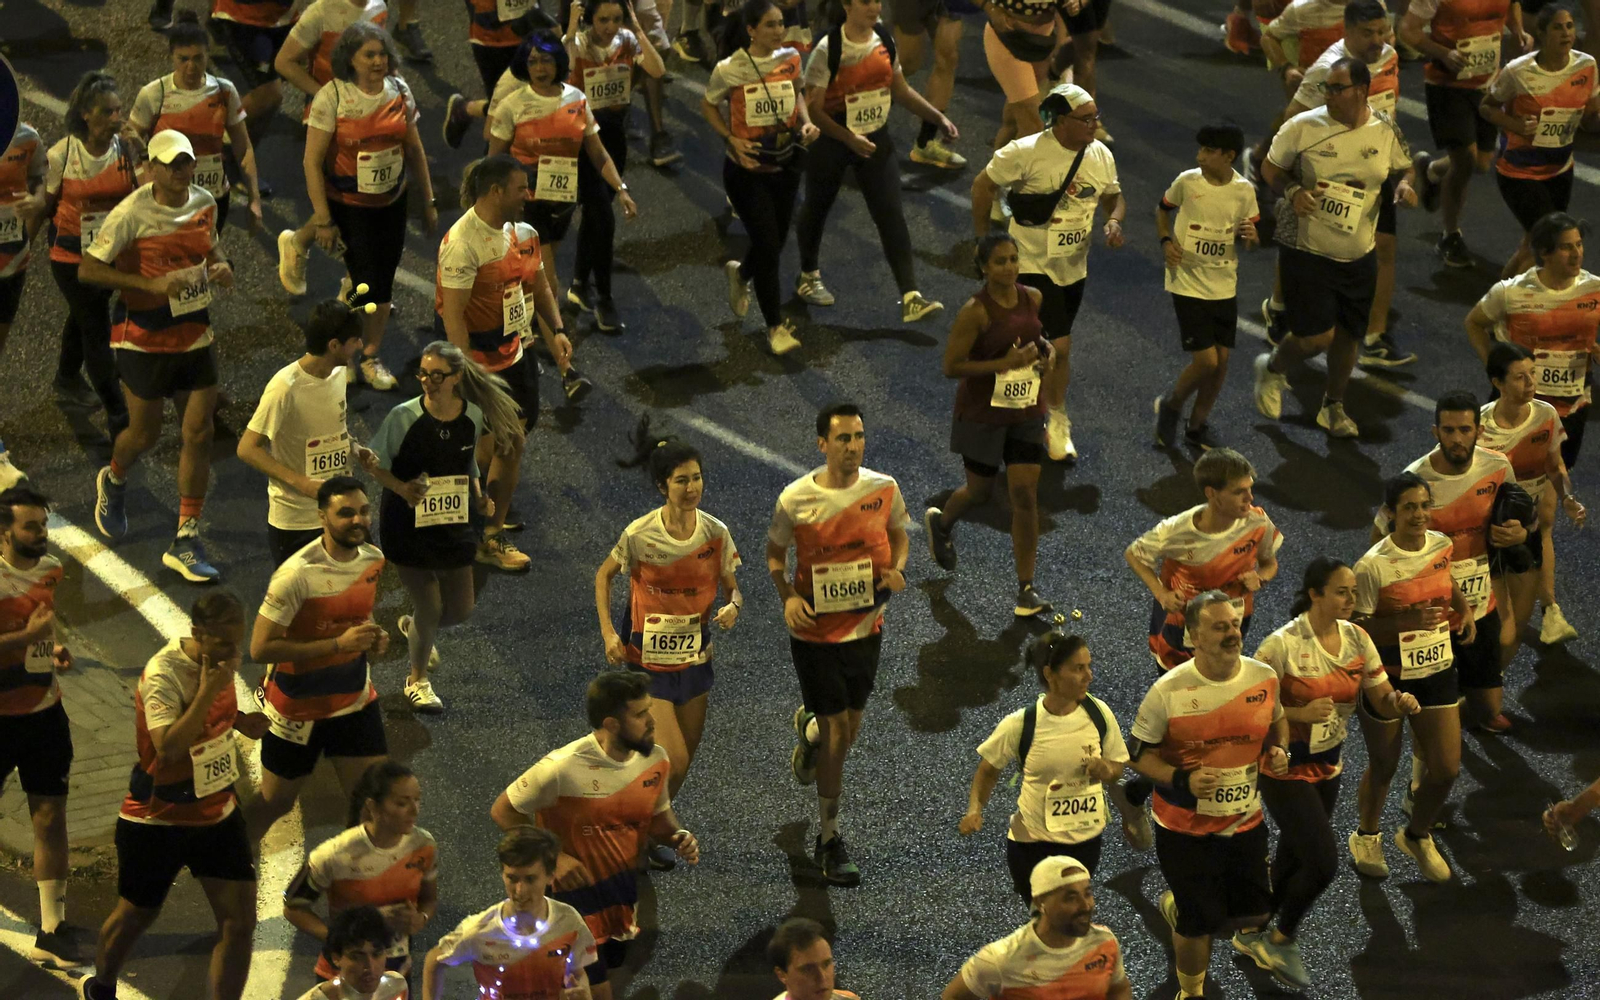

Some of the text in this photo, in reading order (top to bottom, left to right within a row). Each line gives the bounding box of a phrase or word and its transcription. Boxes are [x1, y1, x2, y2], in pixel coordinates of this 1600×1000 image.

[590, 82, 625, 98] 10595
[755, 99, 784, 114] 8001
[855, 106, 883, 123] 4582
[371, 166, 392, 182] 787
[549, 174, 569, 189] 782
[1320, 197, 1351, 219] 1001
[1057, 229, 1087, 247] 2602
[1195, 240, 1226, 256] 1005
[1542, 368, 1576, 383] 8641
[1004, 380, 1033, 397] 8887
[311, 450, 348, 471] 16186
[421, 495, 461, 513] 16190
[820, 579, 867, 599] 16568
[1456, 575, 1484, 595] 477
[650, 634, 695, 650] 16572
[1407, 643, 1446, 667] 16487
[1246, 689, 1268, 704] KH7
[204, 753, 232, 780] 7869
[1210, 784, 1251, 803] 6629
[1052, 796, 1097, 816] 22042
